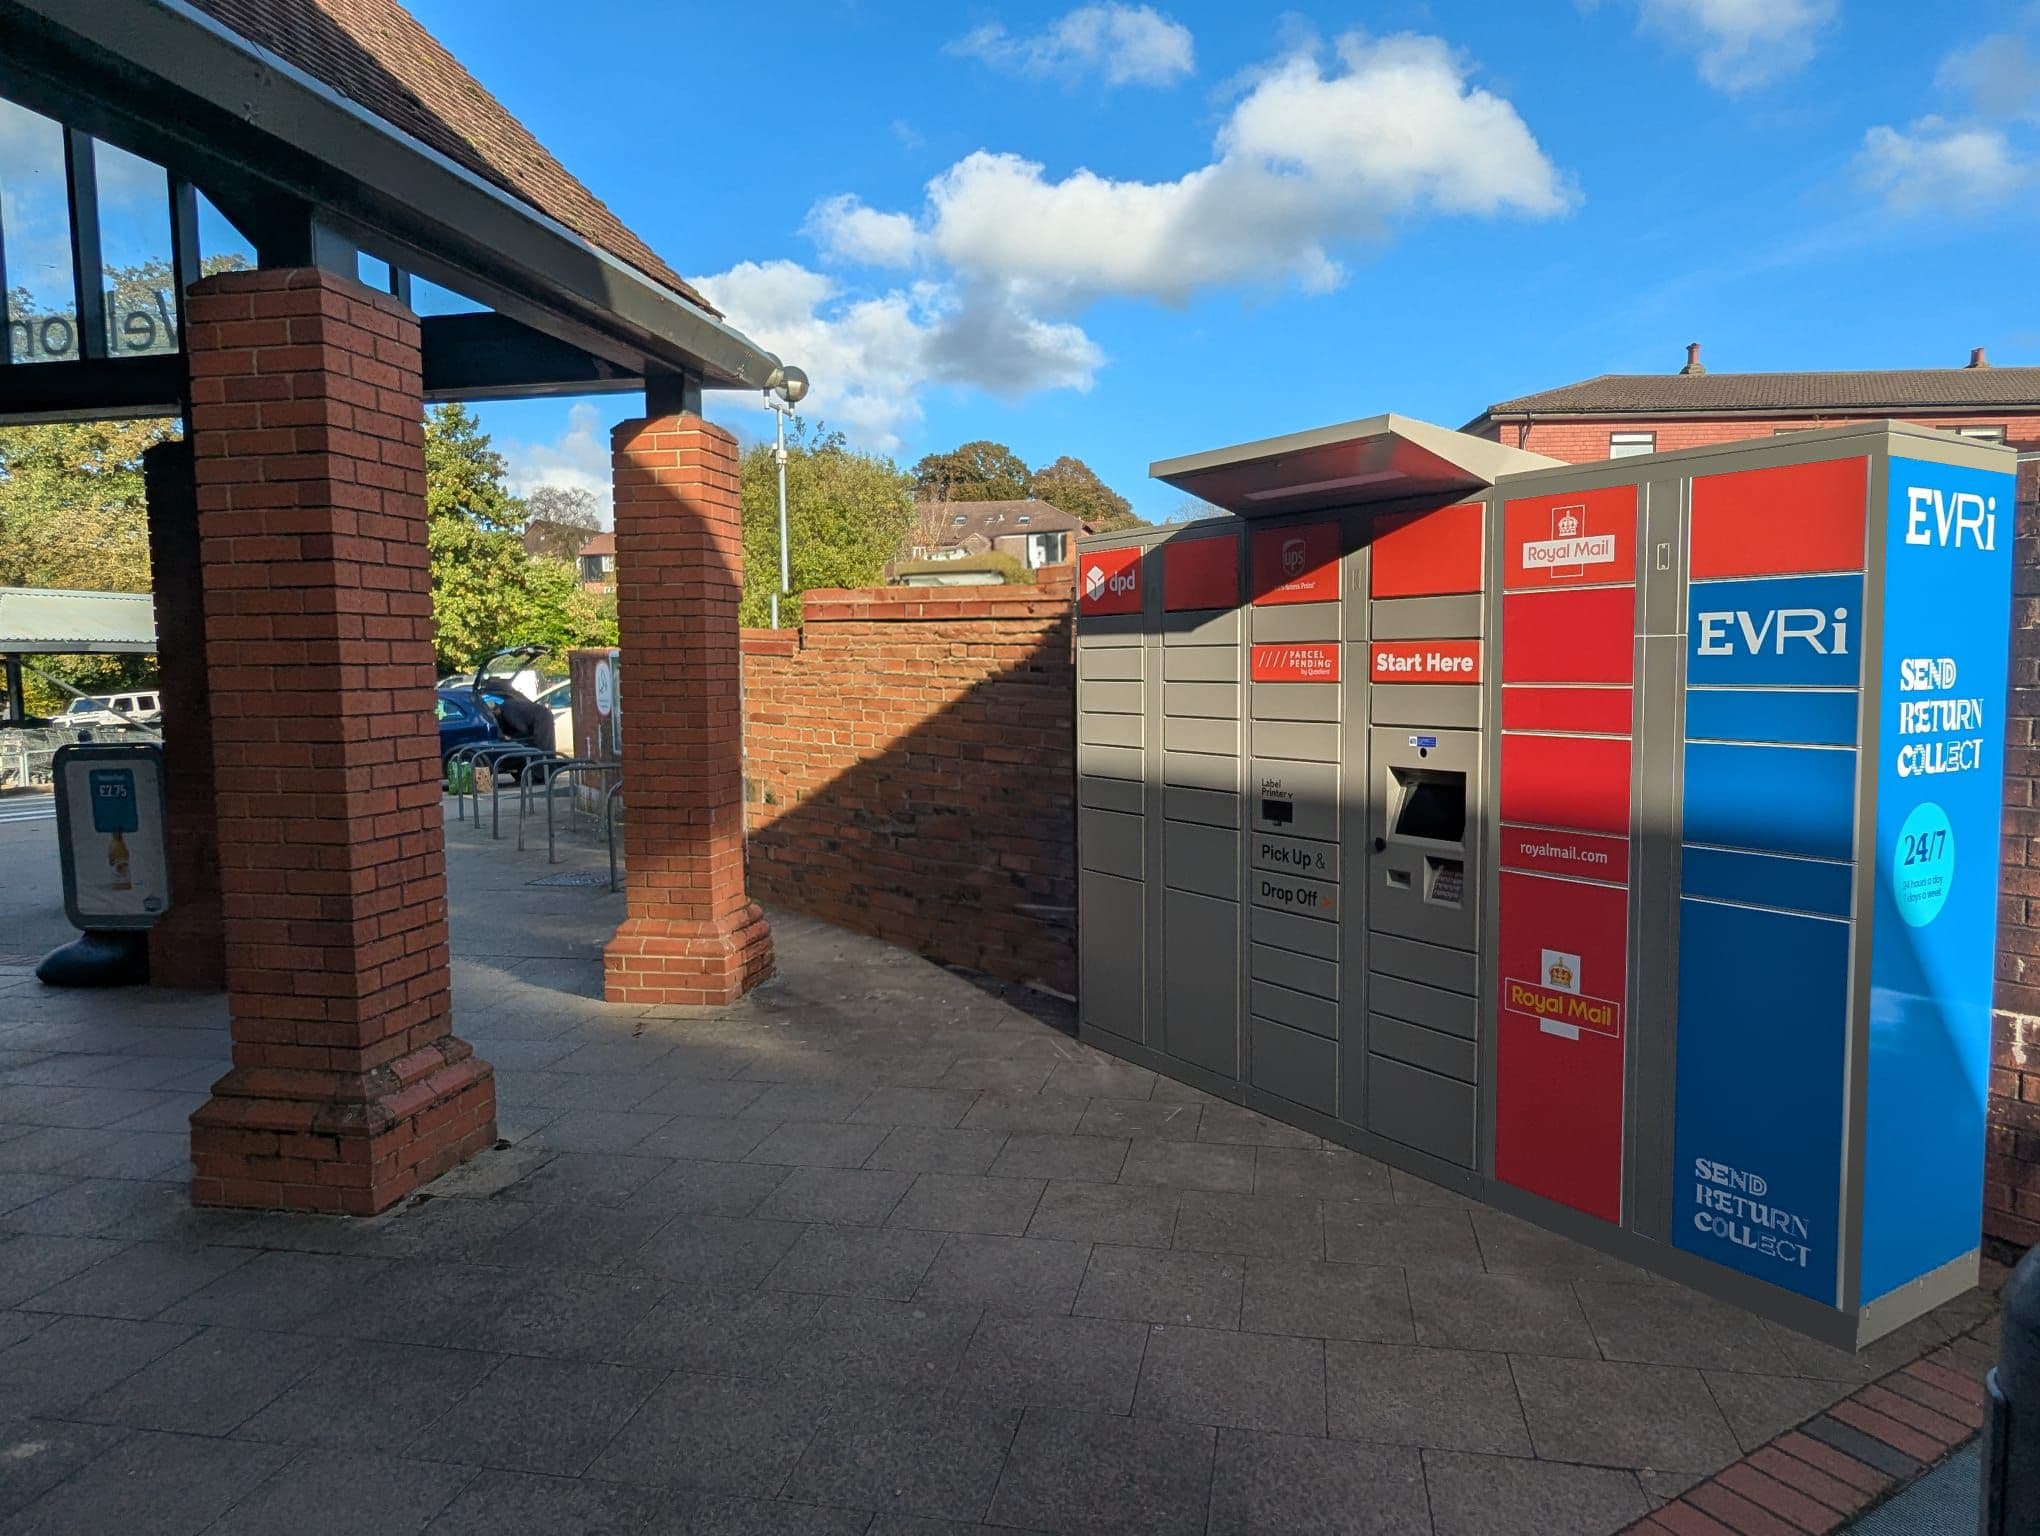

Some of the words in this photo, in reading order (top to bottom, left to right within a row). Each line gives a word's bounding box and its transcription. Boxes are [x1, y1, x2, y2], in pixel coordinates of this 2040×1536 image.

[1905, 486, 1996, 551] EVRi
[1528, 543, 1570, 563] Royal
[1574, 539, 1609, 557] Mail
[1109, 569, 1136, 597] dpd
[1697, 607, 1849, 656] EVRi
[1289, 650, 1325, 659] PARCEL
[1289, 659, 1332, 668] PENDING
[1377, 652, 1422, 672] Start
[1426, 652, 1474, 672] Here
[1900, 657, 1957, 692] SEND
[1899, 698, 1984, 735] RETURN
[1897, 739, 1984, 778] COLLECT
[1261, 778, 1282, 789] Label
[1261, 787, 1287, 799] Printer
[1262, 844, 1288, 863] Pick
[1292, 849, 1312, 869] Up
[1315, 853, 1326, 870] &
[1520, 842, 1608, 865] royalmail.com
[1904, 829, 1947, 866] 24/7
[1261, 881, 1293, 901] Drop
[1296, 888, 1318, 907] Off
[1511, 984, 1563, 1014] Royal
[1567, 998, 1611, 1026] Mail
[1695, 1157, 1768, 1196] SEND
[1695, 1183, 1810, 1240] RETURN
[1694, 1211, 1812, 1268] COLLECT
